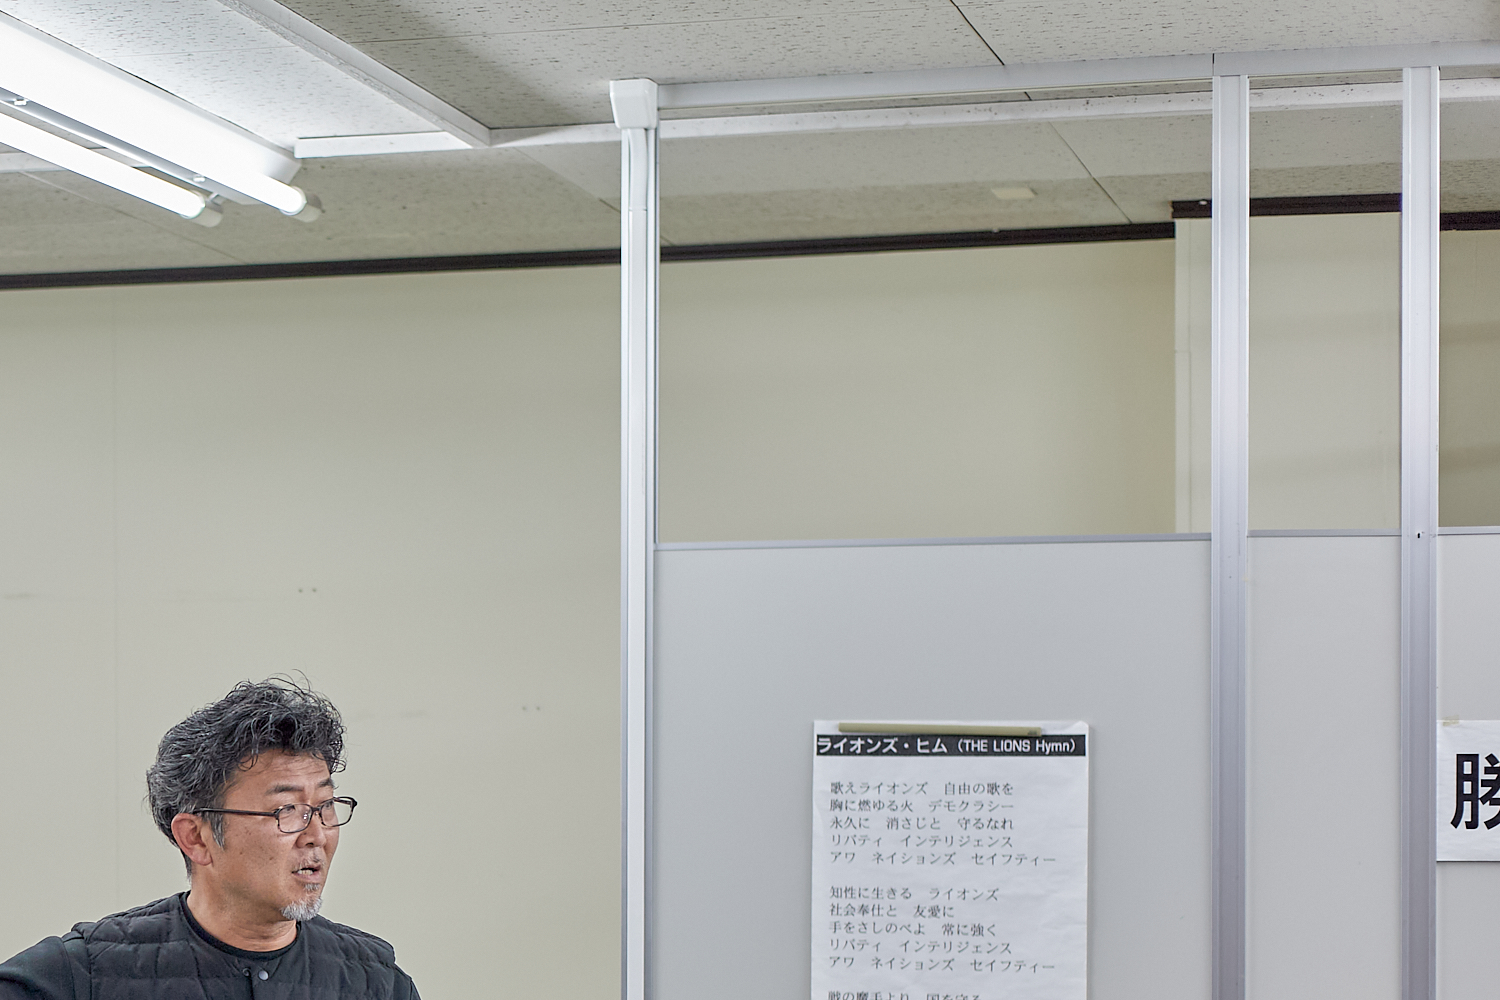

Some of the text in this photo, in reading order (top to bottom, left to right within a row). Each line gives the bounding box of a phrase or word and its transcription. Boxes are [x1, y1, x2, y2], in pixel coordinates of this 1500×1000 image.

[817, 737, 948, 754] ライオンズ・ヒム
[994, 739, 1030, 753] LIONS
[830, 781, 1014, 796] 歌えライオンズ 自由の歌を
[829, 798, 1014, 813] 胸に燃ゆる火 デモクラシー
[829, 815, 1014, 831] 永久に 消さじと 守るなれ
[900, 834, 1013, 848] インテリジェンス
[830, 851, 1056, 867] アワ ネイションズ セイフティー
[829, 885, 1000, 902] 知性に生きる ライオンズ
[830, 902, 955, 919] 社会奉仕と 友愛に
[829, 920, 996, 938] 手をさしのべよ 常に強く
[899, 940, 1012, 955] インテリジェンス
[829, 956, 1055, 973] アワ ネイションズ セイフティー
